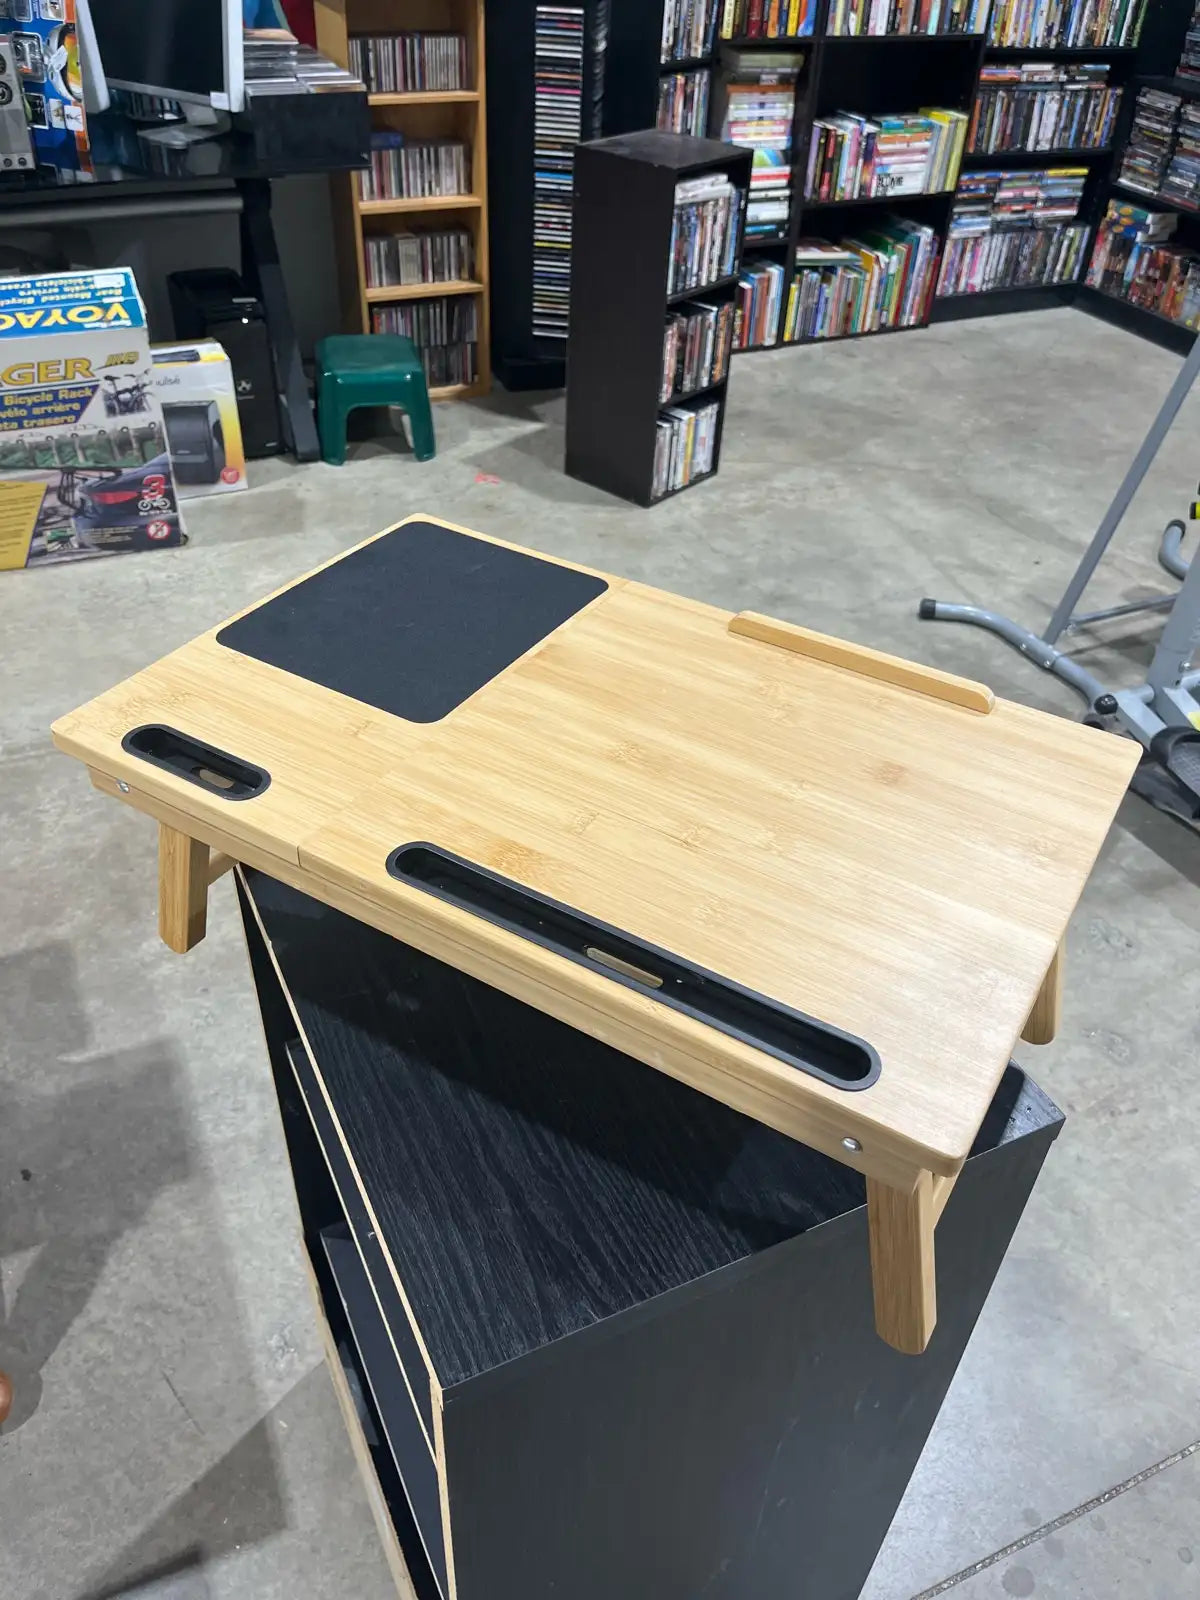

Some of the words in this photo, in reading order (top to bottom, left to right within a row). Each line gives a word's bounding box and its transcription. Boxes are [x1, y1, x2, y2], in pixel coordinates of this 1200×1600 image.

[41, 292, 92, 303] Mounted
[96, 288, 122, 297] Rear
[0, 297, 35, 307] Bicycl
[0, 356, 96, 387] GER
[4, 391, 53, 406] Bicycle
[58, 387, 93, 400] Rack
[32, 402, 81, 415] arrière
[22, 414, 76, 428] trasero
[142, 473, 166, 501] 3
